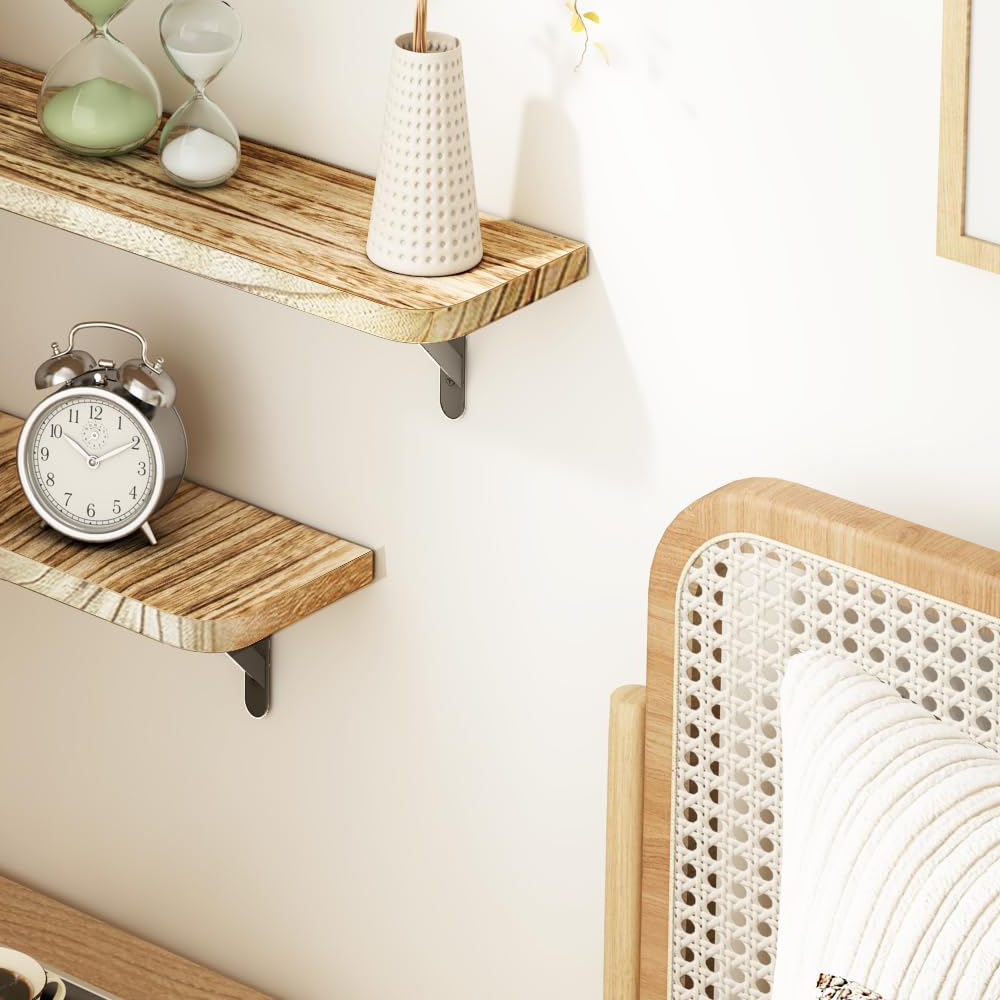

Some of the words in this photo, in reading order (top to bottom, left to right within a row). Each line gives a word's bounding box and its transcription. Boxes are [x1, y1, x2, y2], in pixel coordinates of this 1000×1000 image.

[68, 408, 79, 424] 11
[89, 405, 103, 421] 12
[117, 416, 122, 430] 1
[50, 423, 63, 439] 10
[131, 435, 141, 450] 2
[40, 446, 50, 462] 9
[137, 461, 146, 476] 3
[45, 472, 55, 487] 8
[64, 492, 73, 507] 7
[129, 485, 137, 500] 4
[86, 503, 96, 518] 6
[112, 499, 122, 514] 5
